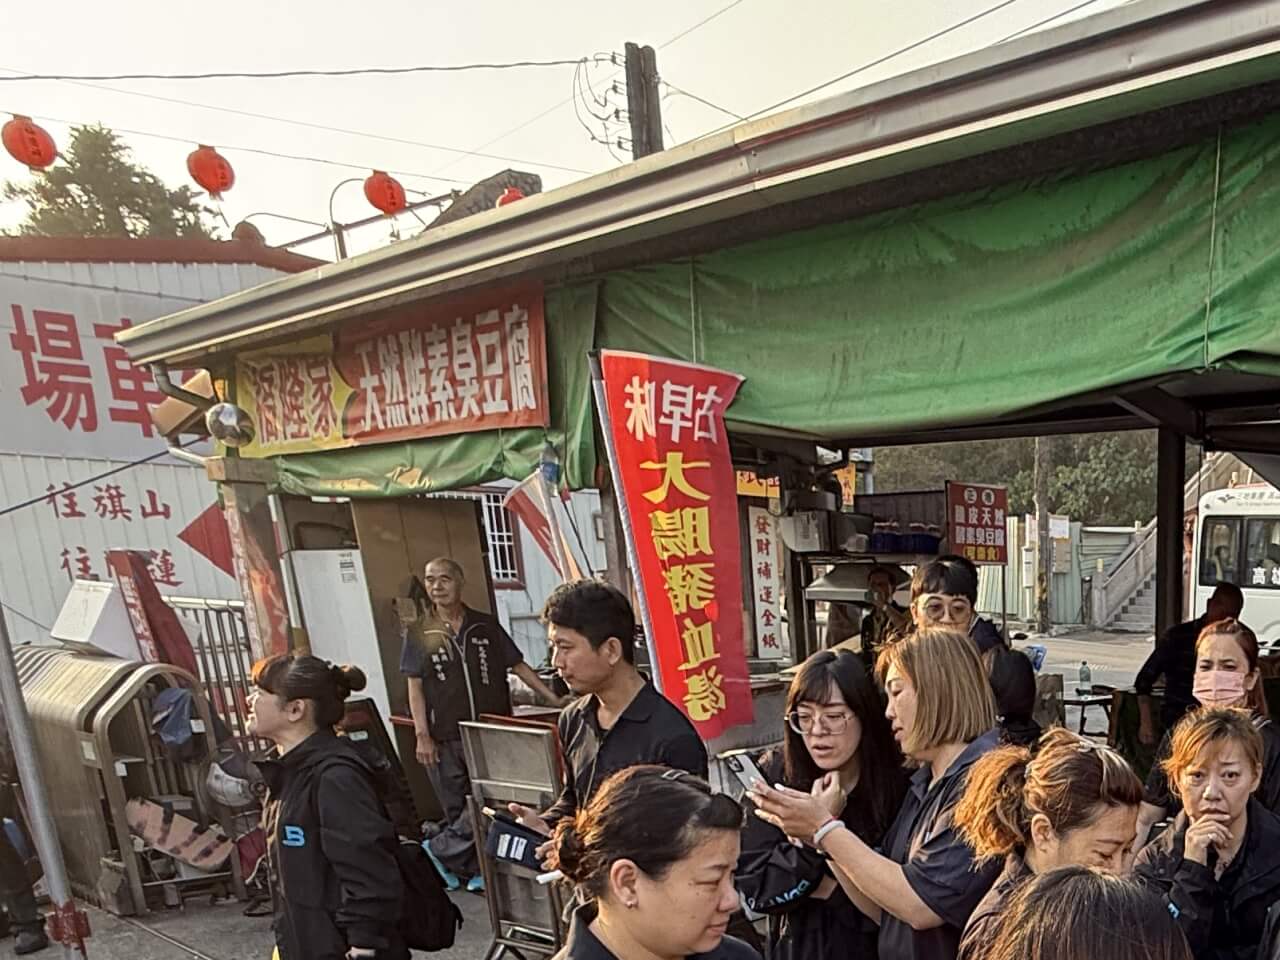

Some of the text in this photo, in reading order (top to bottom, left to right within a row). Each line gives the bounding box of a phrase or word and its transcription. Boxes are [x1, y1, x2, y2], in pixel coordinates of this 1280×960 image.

[354, 303, 537, 433] 天然酵素臭豆腐
[46, 482, 171, 522] 往旗山
[60, 546, 183, 588] 往蓮
[754, 514, 780, 650] 發財補運金紙
